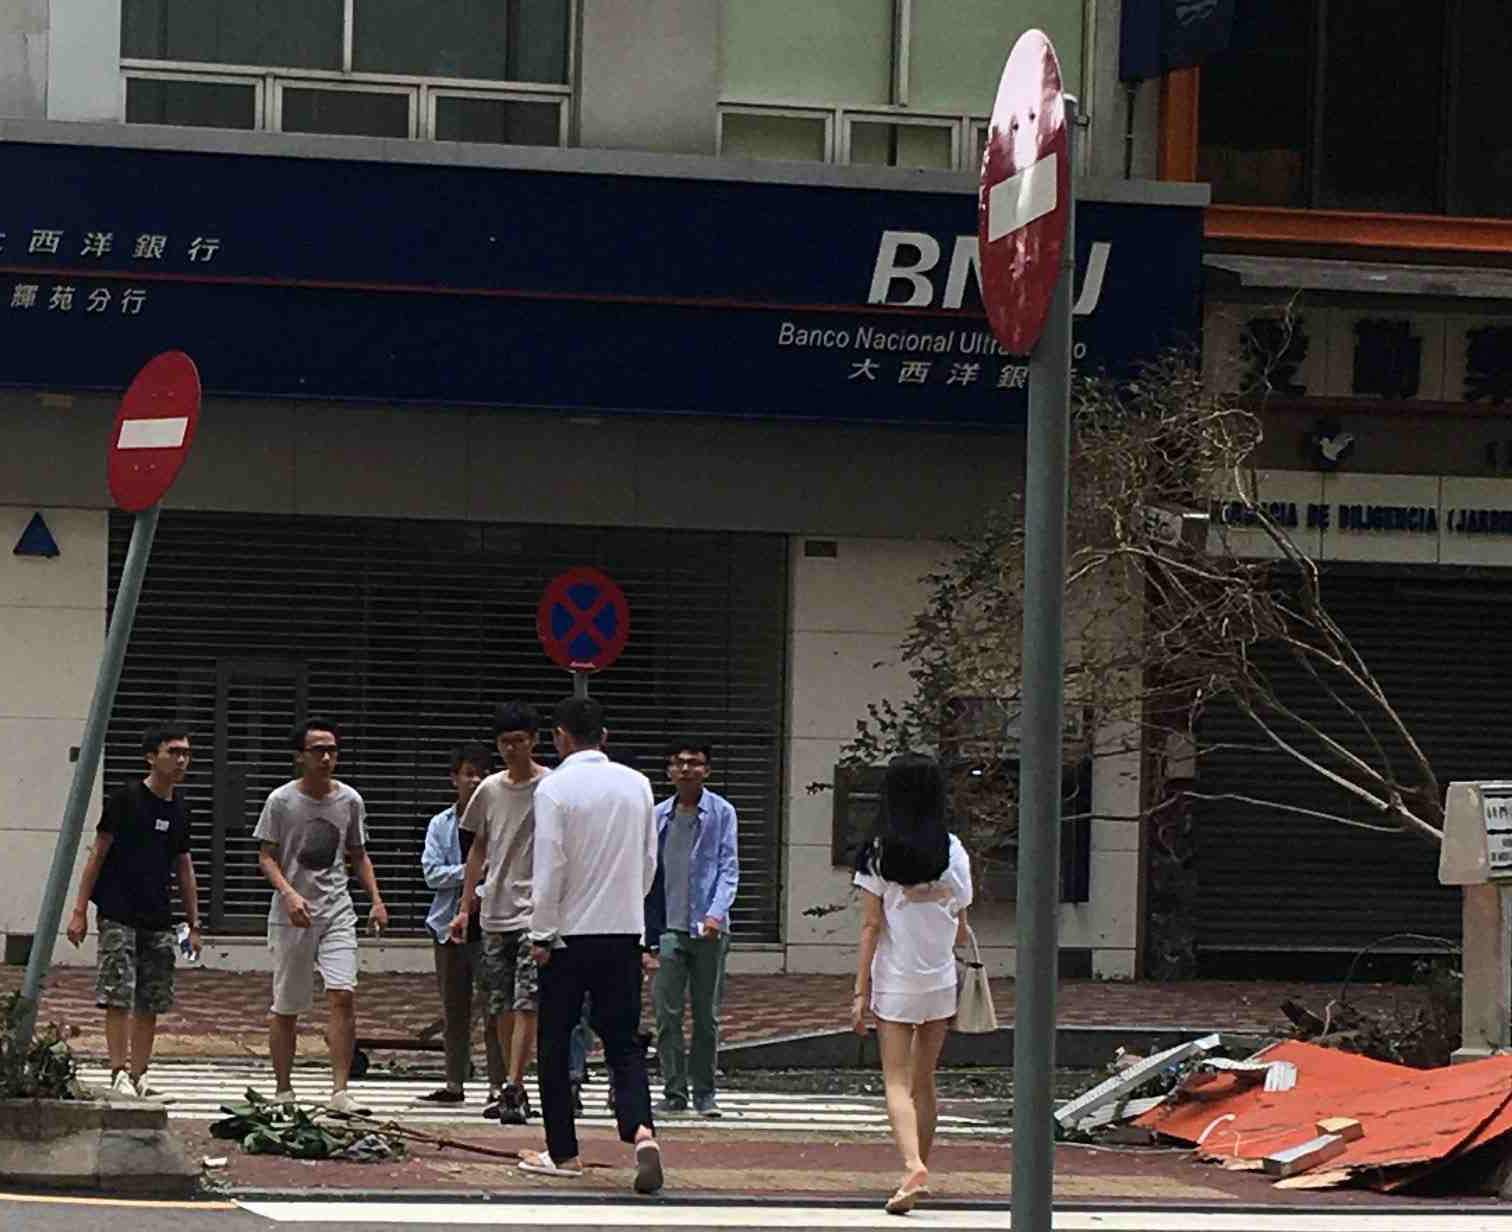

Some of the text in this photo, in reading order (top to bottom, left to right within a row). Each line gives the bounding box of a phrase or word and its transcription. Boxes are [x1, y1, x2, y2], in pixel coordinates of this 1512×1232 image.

[777, 321, 850, 350] Banco
[853, 326, 954, 354] Nacional
[847, 357, 1078, 391] 大西洋銀
